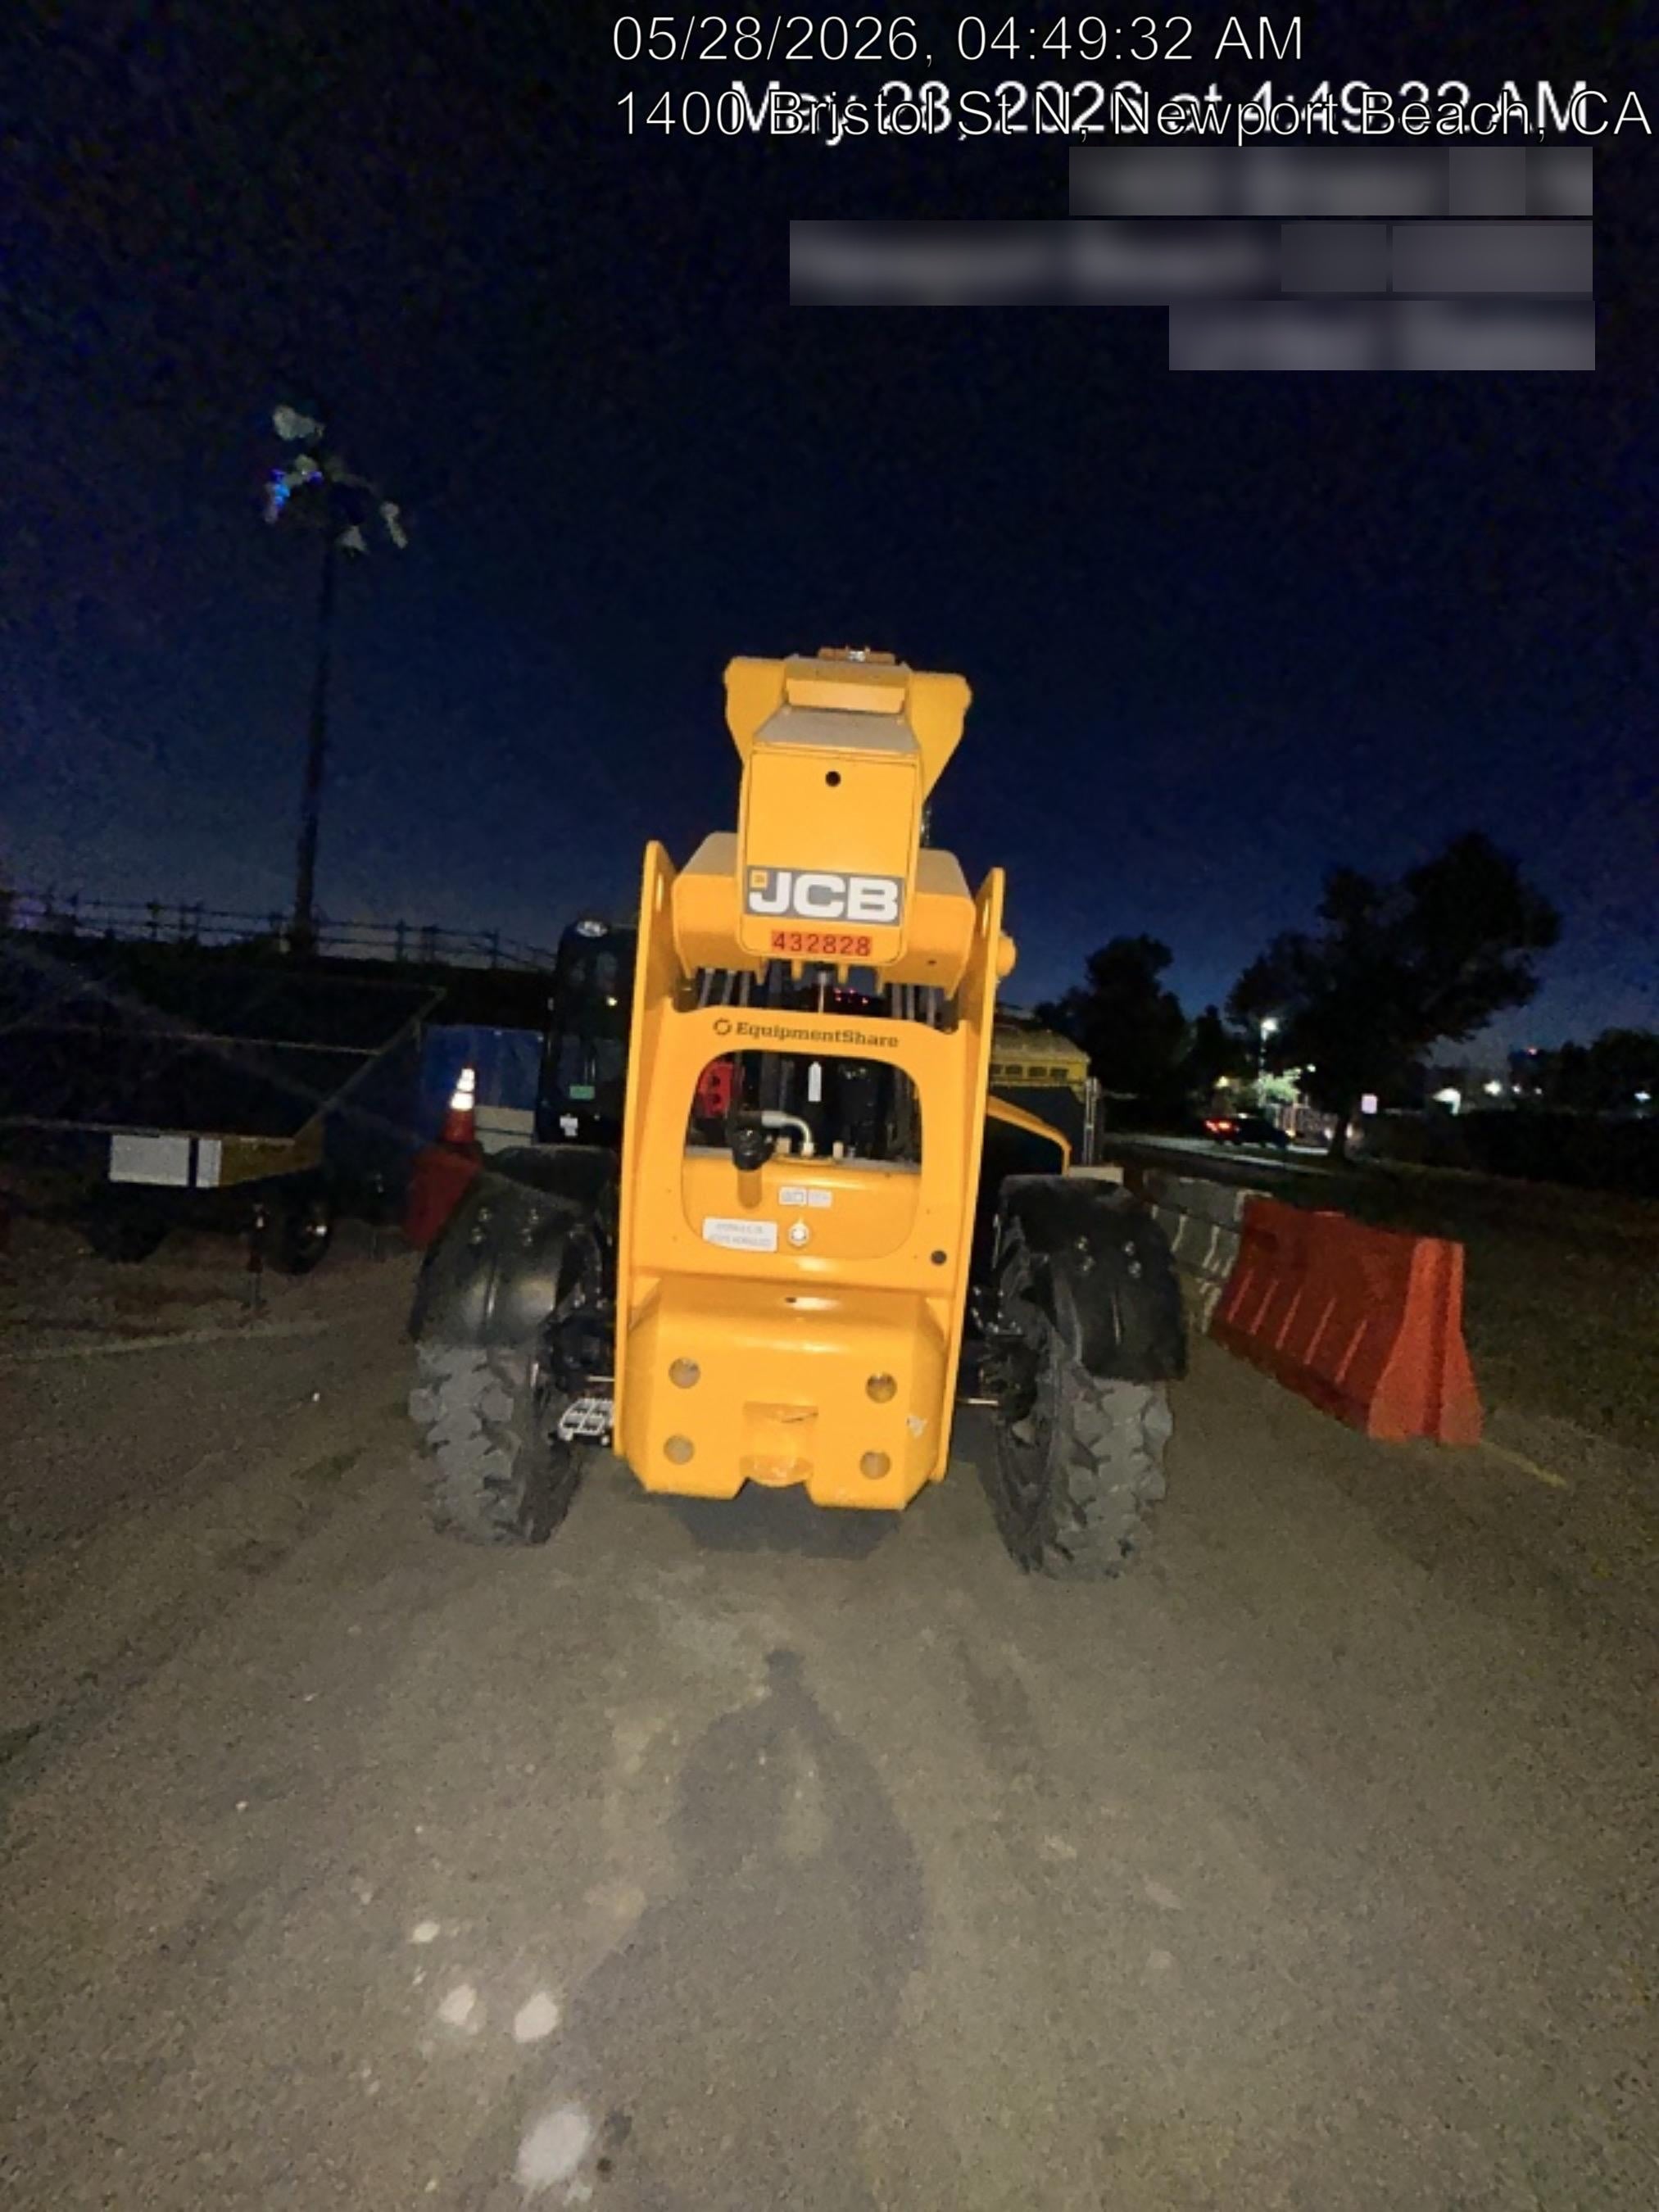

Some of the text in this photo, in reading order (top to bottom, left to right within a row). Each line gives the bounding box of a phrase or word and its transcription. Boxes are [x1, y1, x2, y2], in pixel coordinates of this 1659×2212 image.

[748, 870, 900, 922] JCB
[773, 931, 872, 957] 432828
[735, 1021, 900, 1048] EquipmentShare
